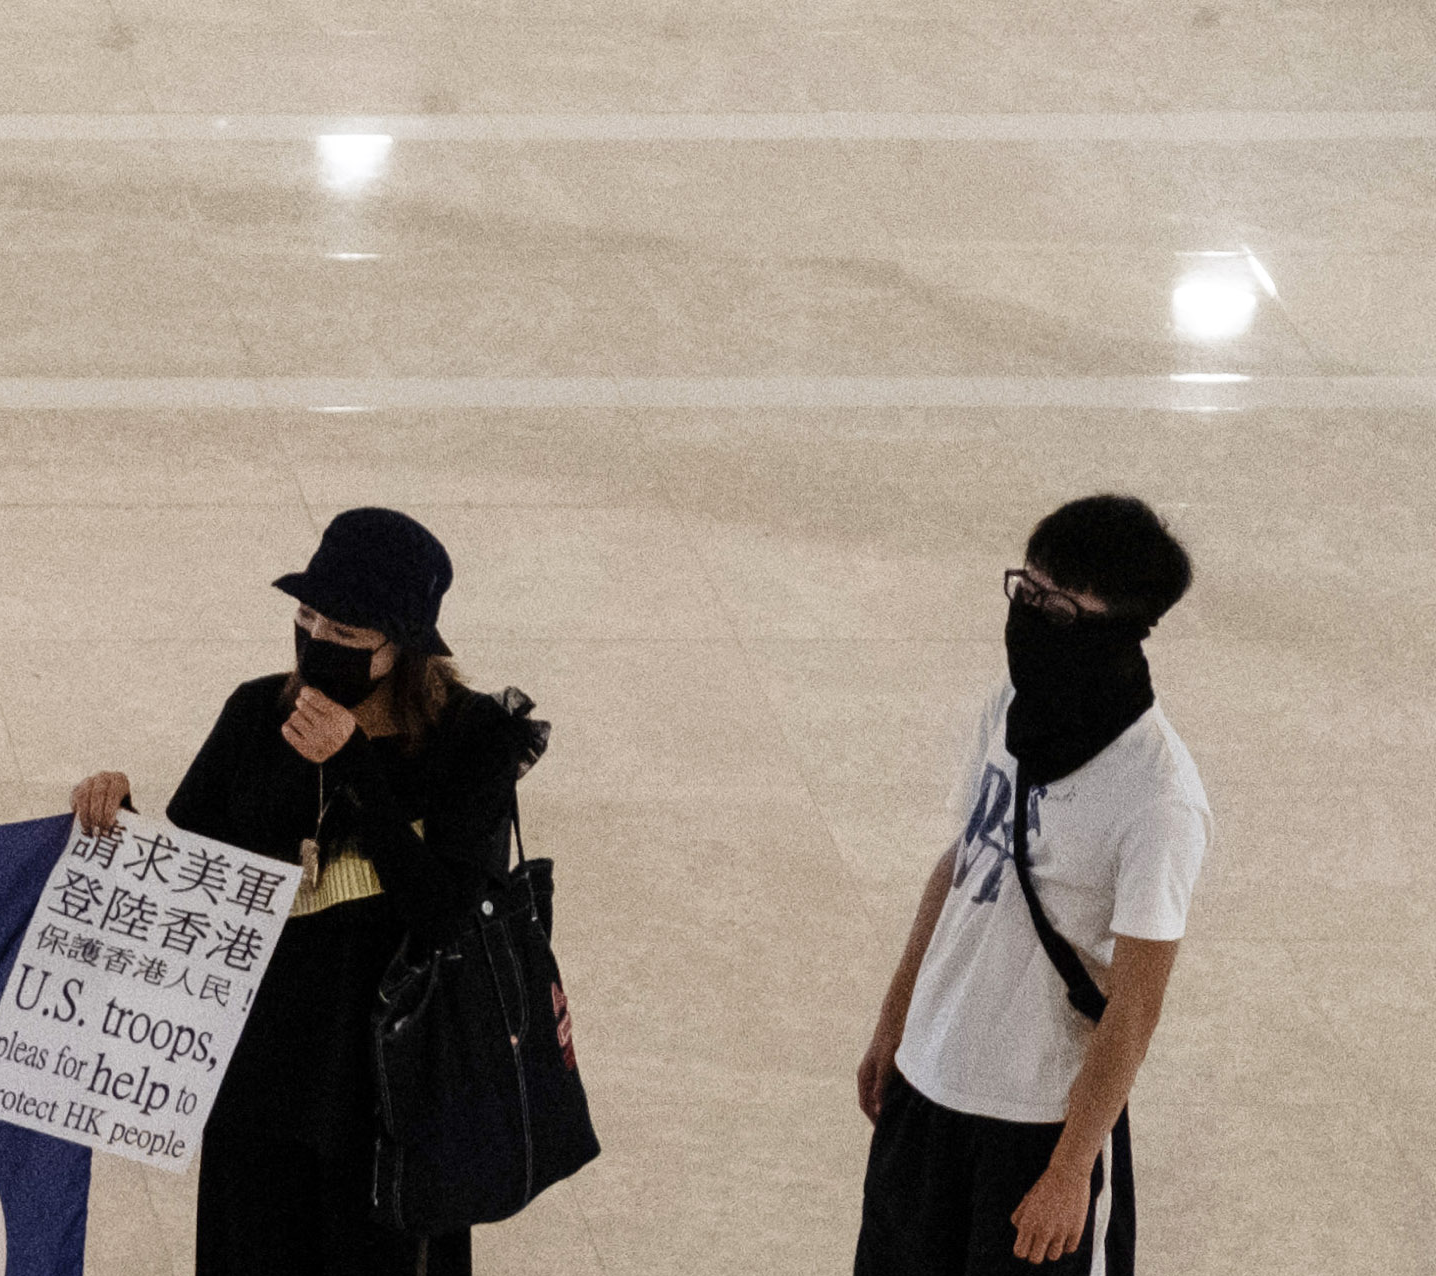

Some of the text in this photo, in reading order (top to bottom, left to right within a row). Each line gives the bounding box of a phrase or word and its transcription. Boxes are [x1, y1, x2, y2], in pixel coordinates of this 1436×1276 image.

[72, 823, 287, 917] 請求美軍
[47, 869, 262, 971] 登陸香港
[15, 964, 218, 1072] U.S. troops,
[56, 1046, 87, 1081] for
[89, 1053, 171, 1116] help
[177, 1087, 197, 1115] to
[65, 1102, 108, 1136] HK
[108, 1117, 185, 1158] people
